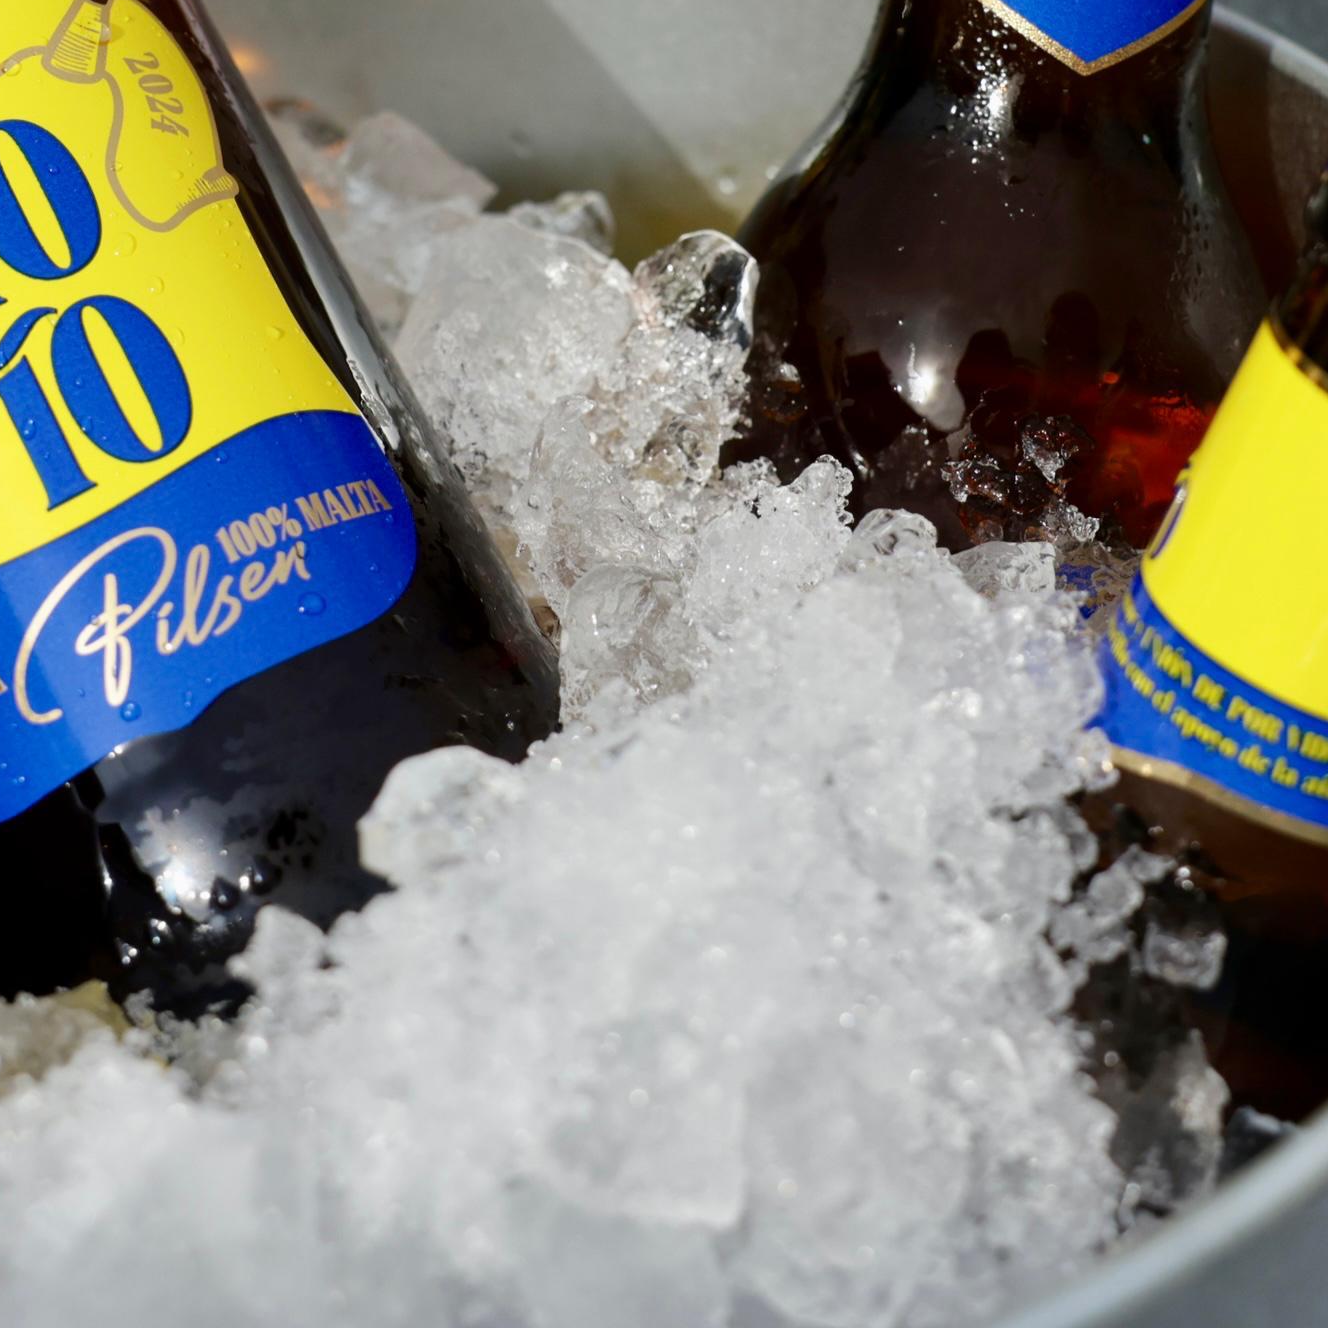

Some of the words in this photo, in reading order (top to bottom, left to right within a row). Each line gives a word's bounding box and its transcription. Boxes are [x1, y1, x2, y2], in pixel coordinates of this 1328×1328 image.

[122, 51, 190, 138] 2024
[215, 502, 302, 564] 100%
[295, 479, 393, 532] MALTA
[13, 525, 312, 725] Pilsen
[1238, 744, 1270, 775] de
[1271, 757, 1299, 788] la
